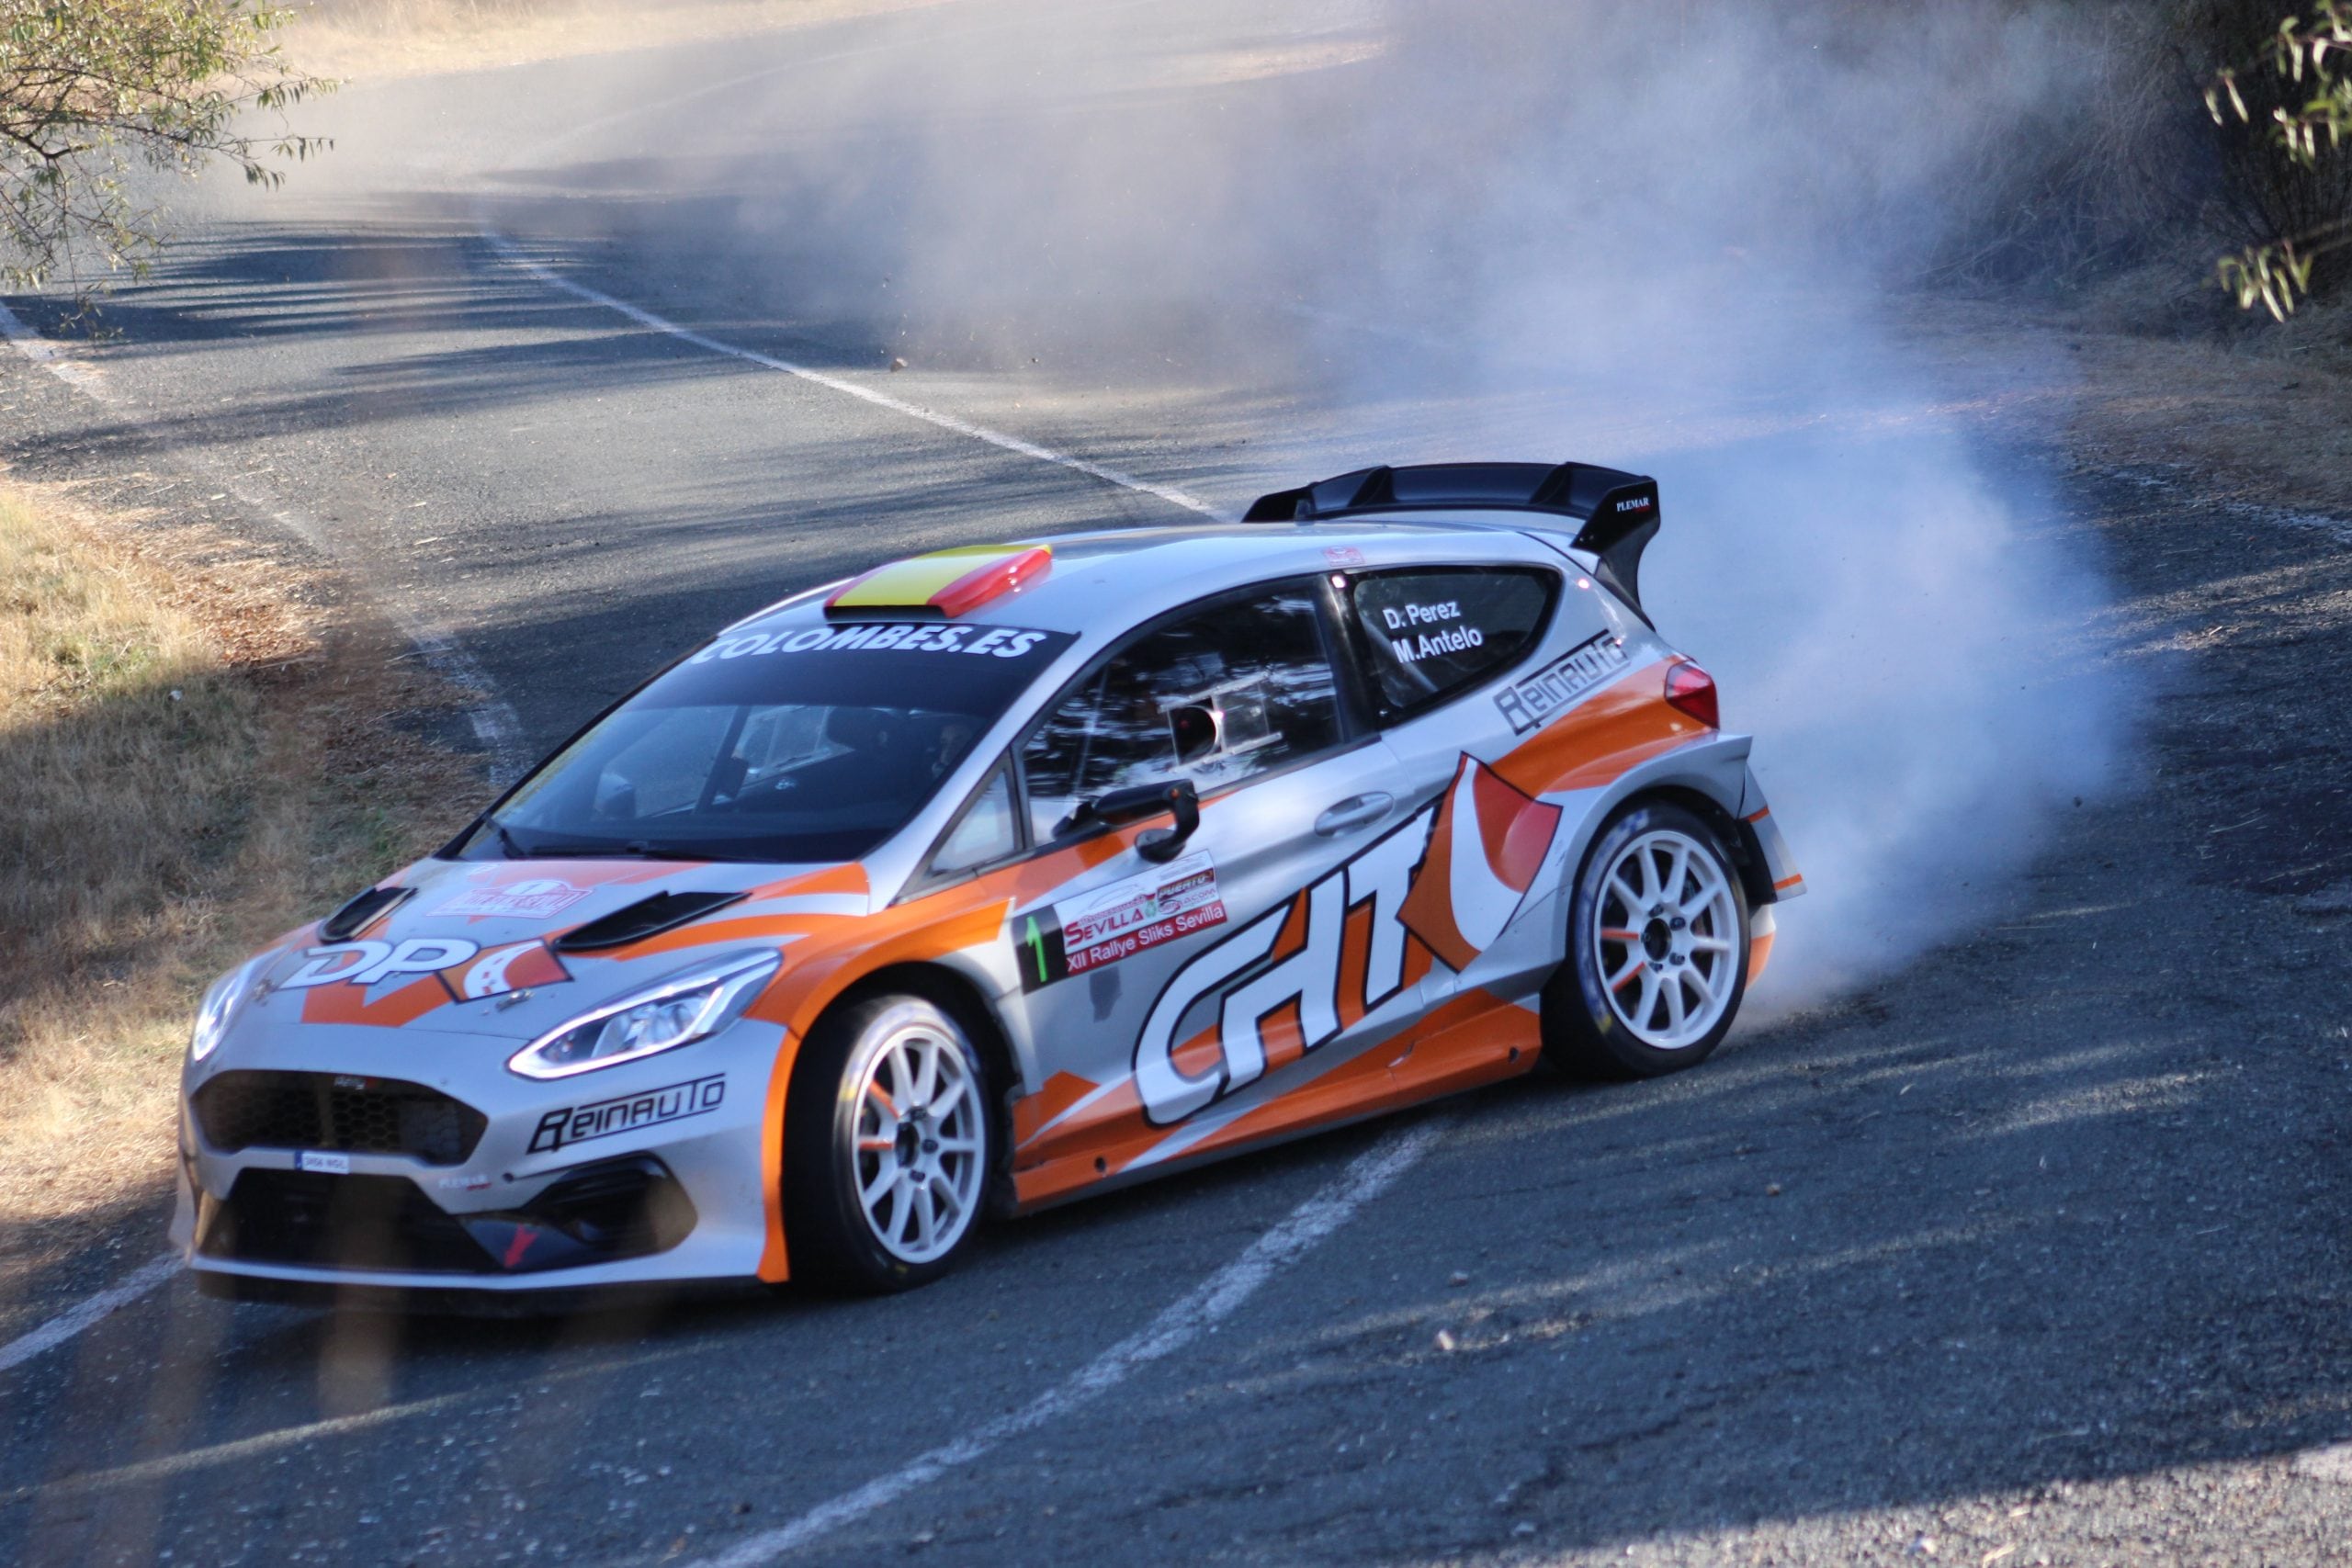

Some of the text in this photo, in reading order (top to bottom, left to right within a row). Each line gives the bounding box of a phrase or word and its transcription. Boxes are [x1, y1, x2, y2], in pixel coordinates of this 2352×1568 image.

[1616, 497, 1650, 512] PLEMAR
[1383, 599, 1461, 630] D. Perez
[1025, 916, 1048, 982] 1
[1090, 936, 1136, 962] Rallye
[1138, 922, 1174, 944] Sliks
[1177, 904, 1225, 932] Sevilla
